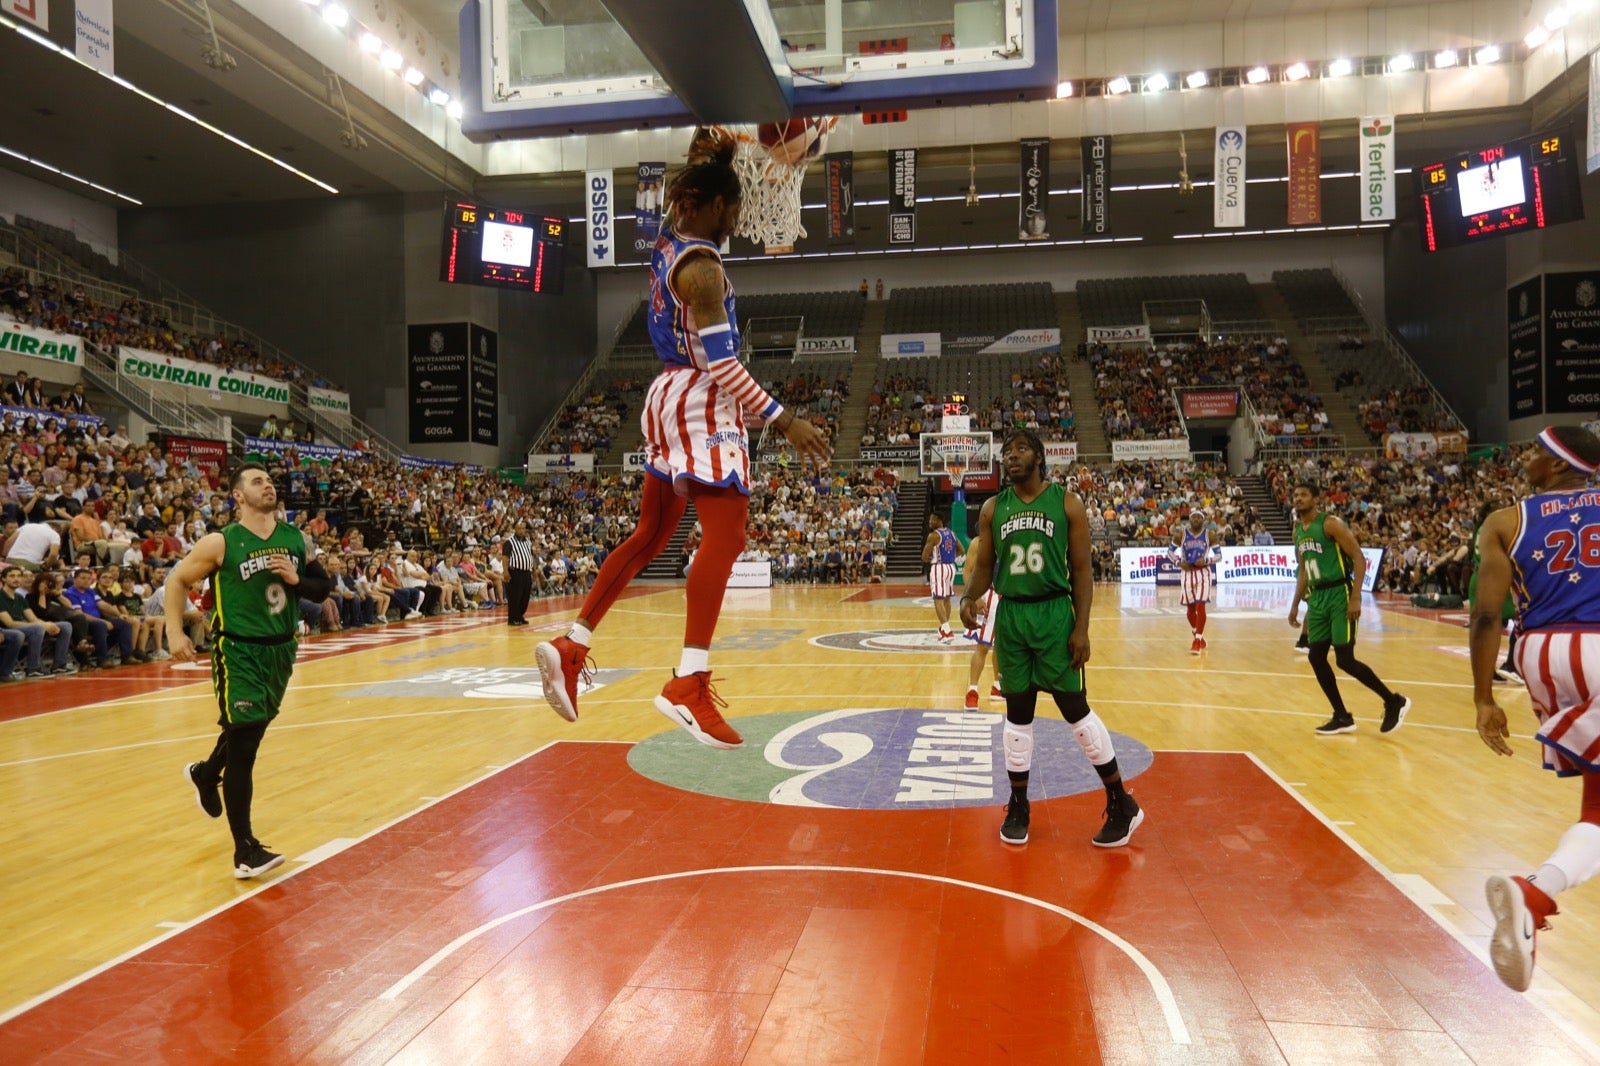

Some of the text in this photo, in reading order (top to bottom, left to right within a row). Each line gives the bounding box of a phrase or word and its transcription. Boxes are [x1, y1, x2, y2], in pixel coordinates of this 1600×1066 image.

[1541, 137, 1560, 154] 52
[895, 150, 904, 196] DE VERDAD
[904, 150, 916, 208] BURGERS
[1368, 142, 1386, 217] fertisac
[1430, 169, 1446, 184] 85
[1226, 156, 1242, 208] Cuerva
[1297, 168, 1307, 209] PEREZ
[1308, 157, 1318, 220] ANTONIO
[1095, 160, 1106, 233] interiorismo
[462, 210, 476, 223] 85
[591, 177, 609, 242] asisa
[548, 224, 561, 236] 52
[1091, 328, 1146, 339] IDEAL
[801, 339, 850, 350] IDEAL
[413, 355, 465, 363] AYUNTAMIENTO
[427, 363, 461, 371] GRANADA
[124, 357, 288, 402] COVIRAN COVIRAN
[310, 395, 348, 411] COVIRAN
[943, 404, 961, 416] 24
[942, 437, 973, 446] HARLEM
[1438, 435, 1462, 449] FP
[1045, 447, 1075, 456] MARCA
[1000, 516, 1055, 541] GENERALS
[249, 547, 289, 559] WASHINGTON
[1545, 522, 1600, 575] 26
[1010, 542, 1046, 576] 26
[1234, 553, 1288, 568] HARLEM
[266, 583, 287, 615] 9
[894, 711, 1003, 804] PULEVA
